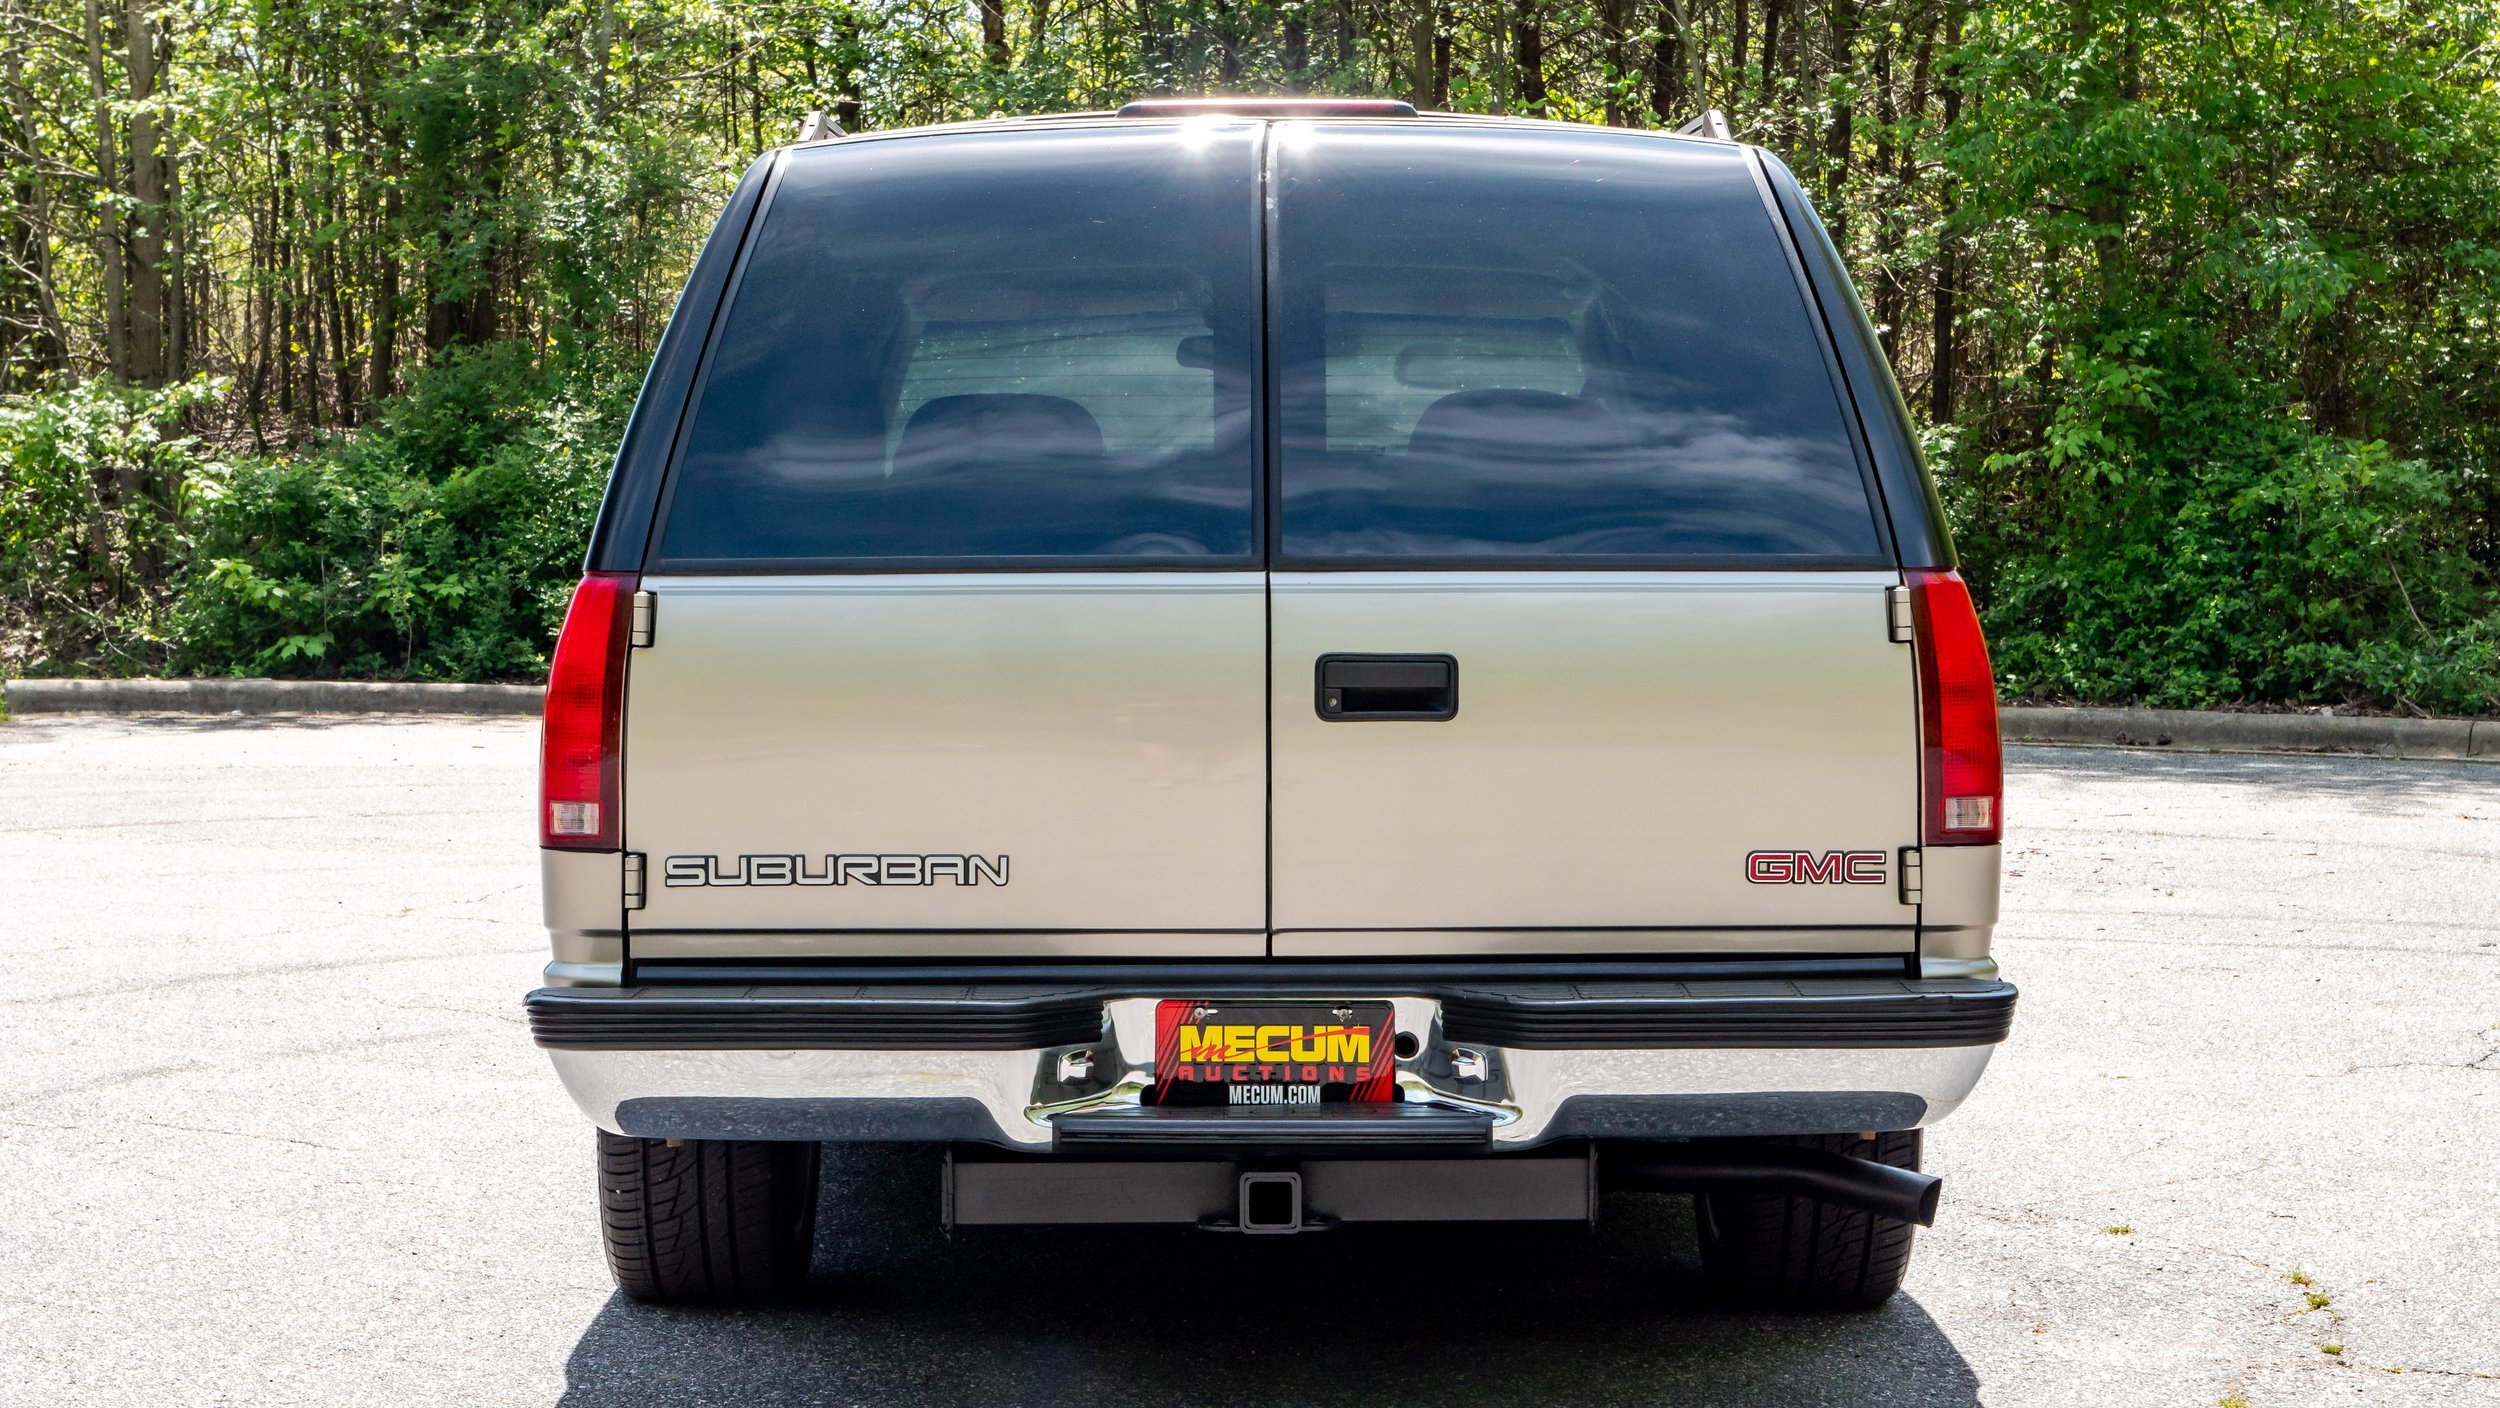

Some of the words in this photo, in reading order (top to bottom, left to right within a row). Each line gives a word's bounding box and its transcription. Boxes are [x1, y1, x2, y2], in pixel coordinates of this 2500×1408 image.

[665, 854, 1009, 887] SUBURBAN
[1746, 850, 1886, 884] GMC
[1179, 1025, 1370, 1062] MECUM
[1178, 1065, 1371, 1081] AUCTIONS
[1229, 1085, 1321, 1105] MECUM.COM
